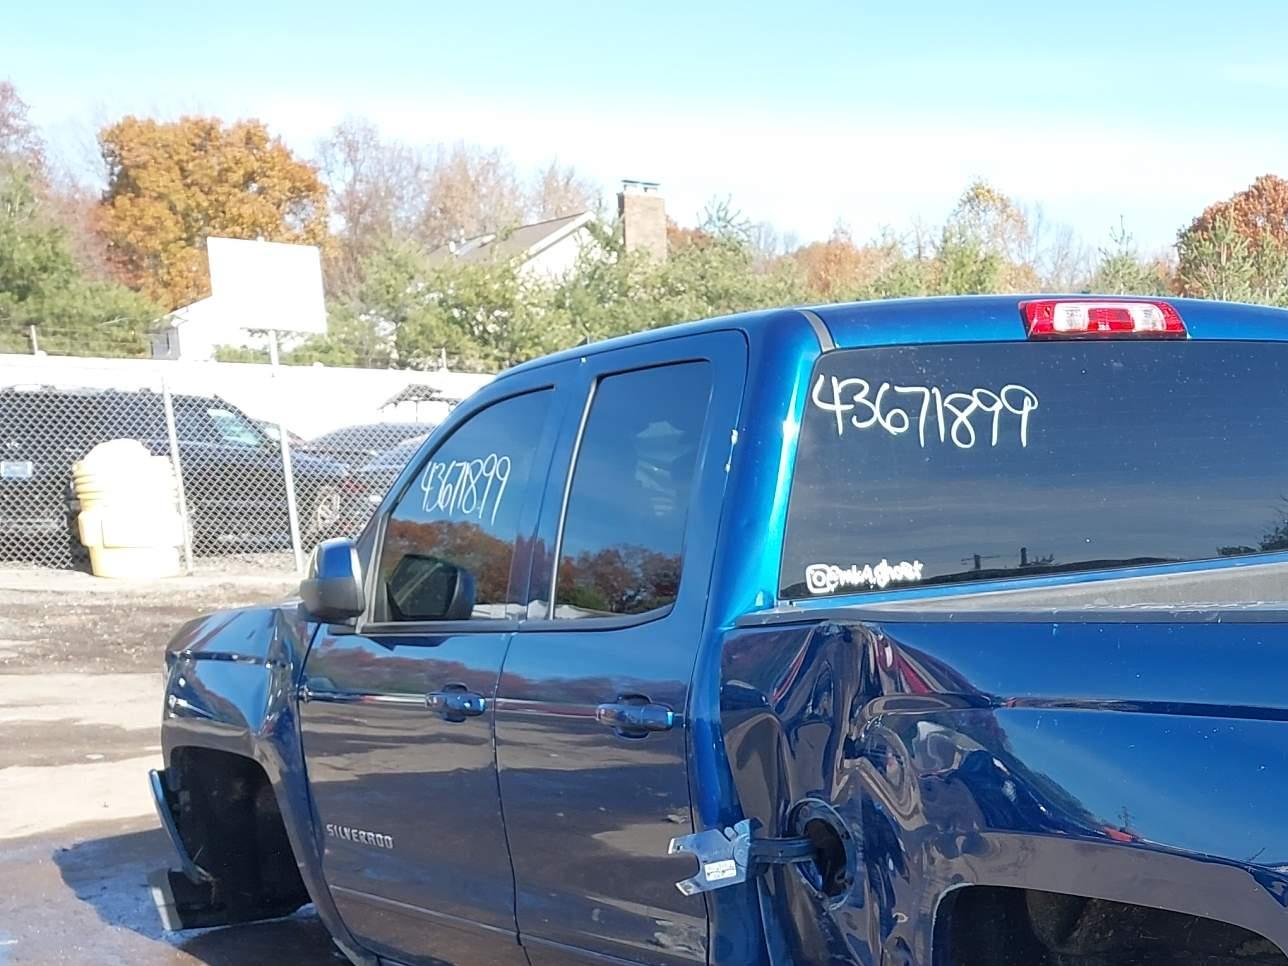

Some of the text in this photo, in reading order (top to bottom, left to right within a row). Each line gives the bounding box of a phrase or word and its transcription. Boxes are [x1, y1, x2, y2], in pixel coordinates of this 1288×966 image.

[811, 374, 1039, 448] 43671899
[421, 453, 511, 527] 43671899
[326, 823, 393, 849] SILVERADO
